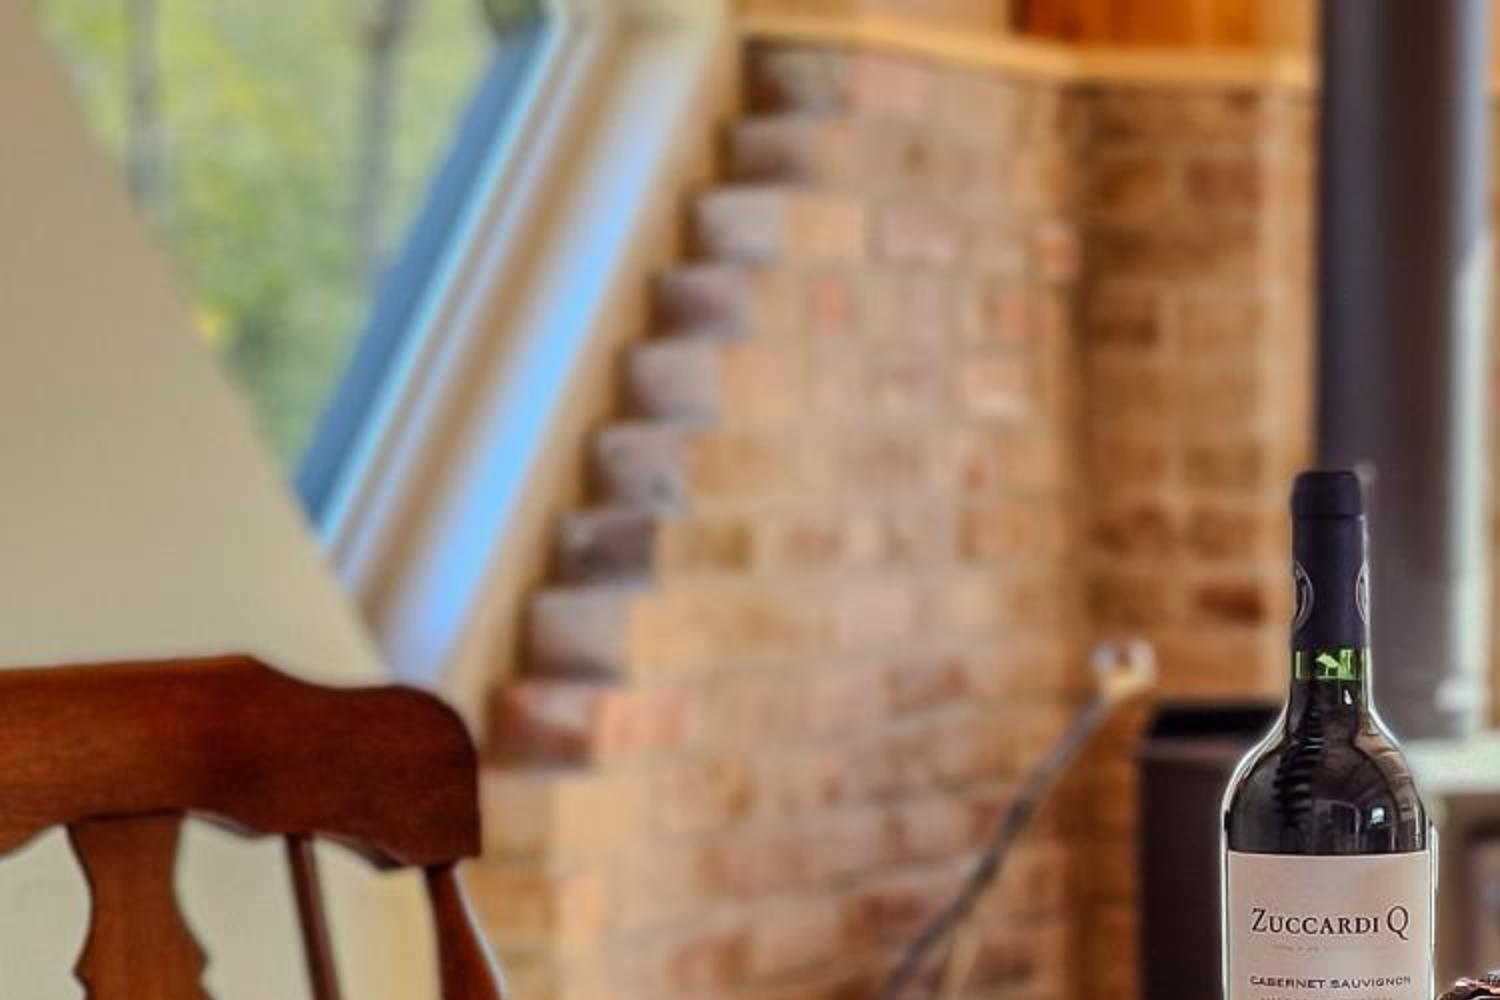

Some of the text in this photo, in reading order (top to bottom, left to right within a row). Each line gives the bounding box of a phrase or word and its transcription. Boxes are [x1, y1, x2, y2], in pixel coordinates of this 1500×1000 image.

[1251, 905, 1409, 940] ZUCCARDI Q
[1249, 975, 1411, 990] CABERNET SAUVIGNON
